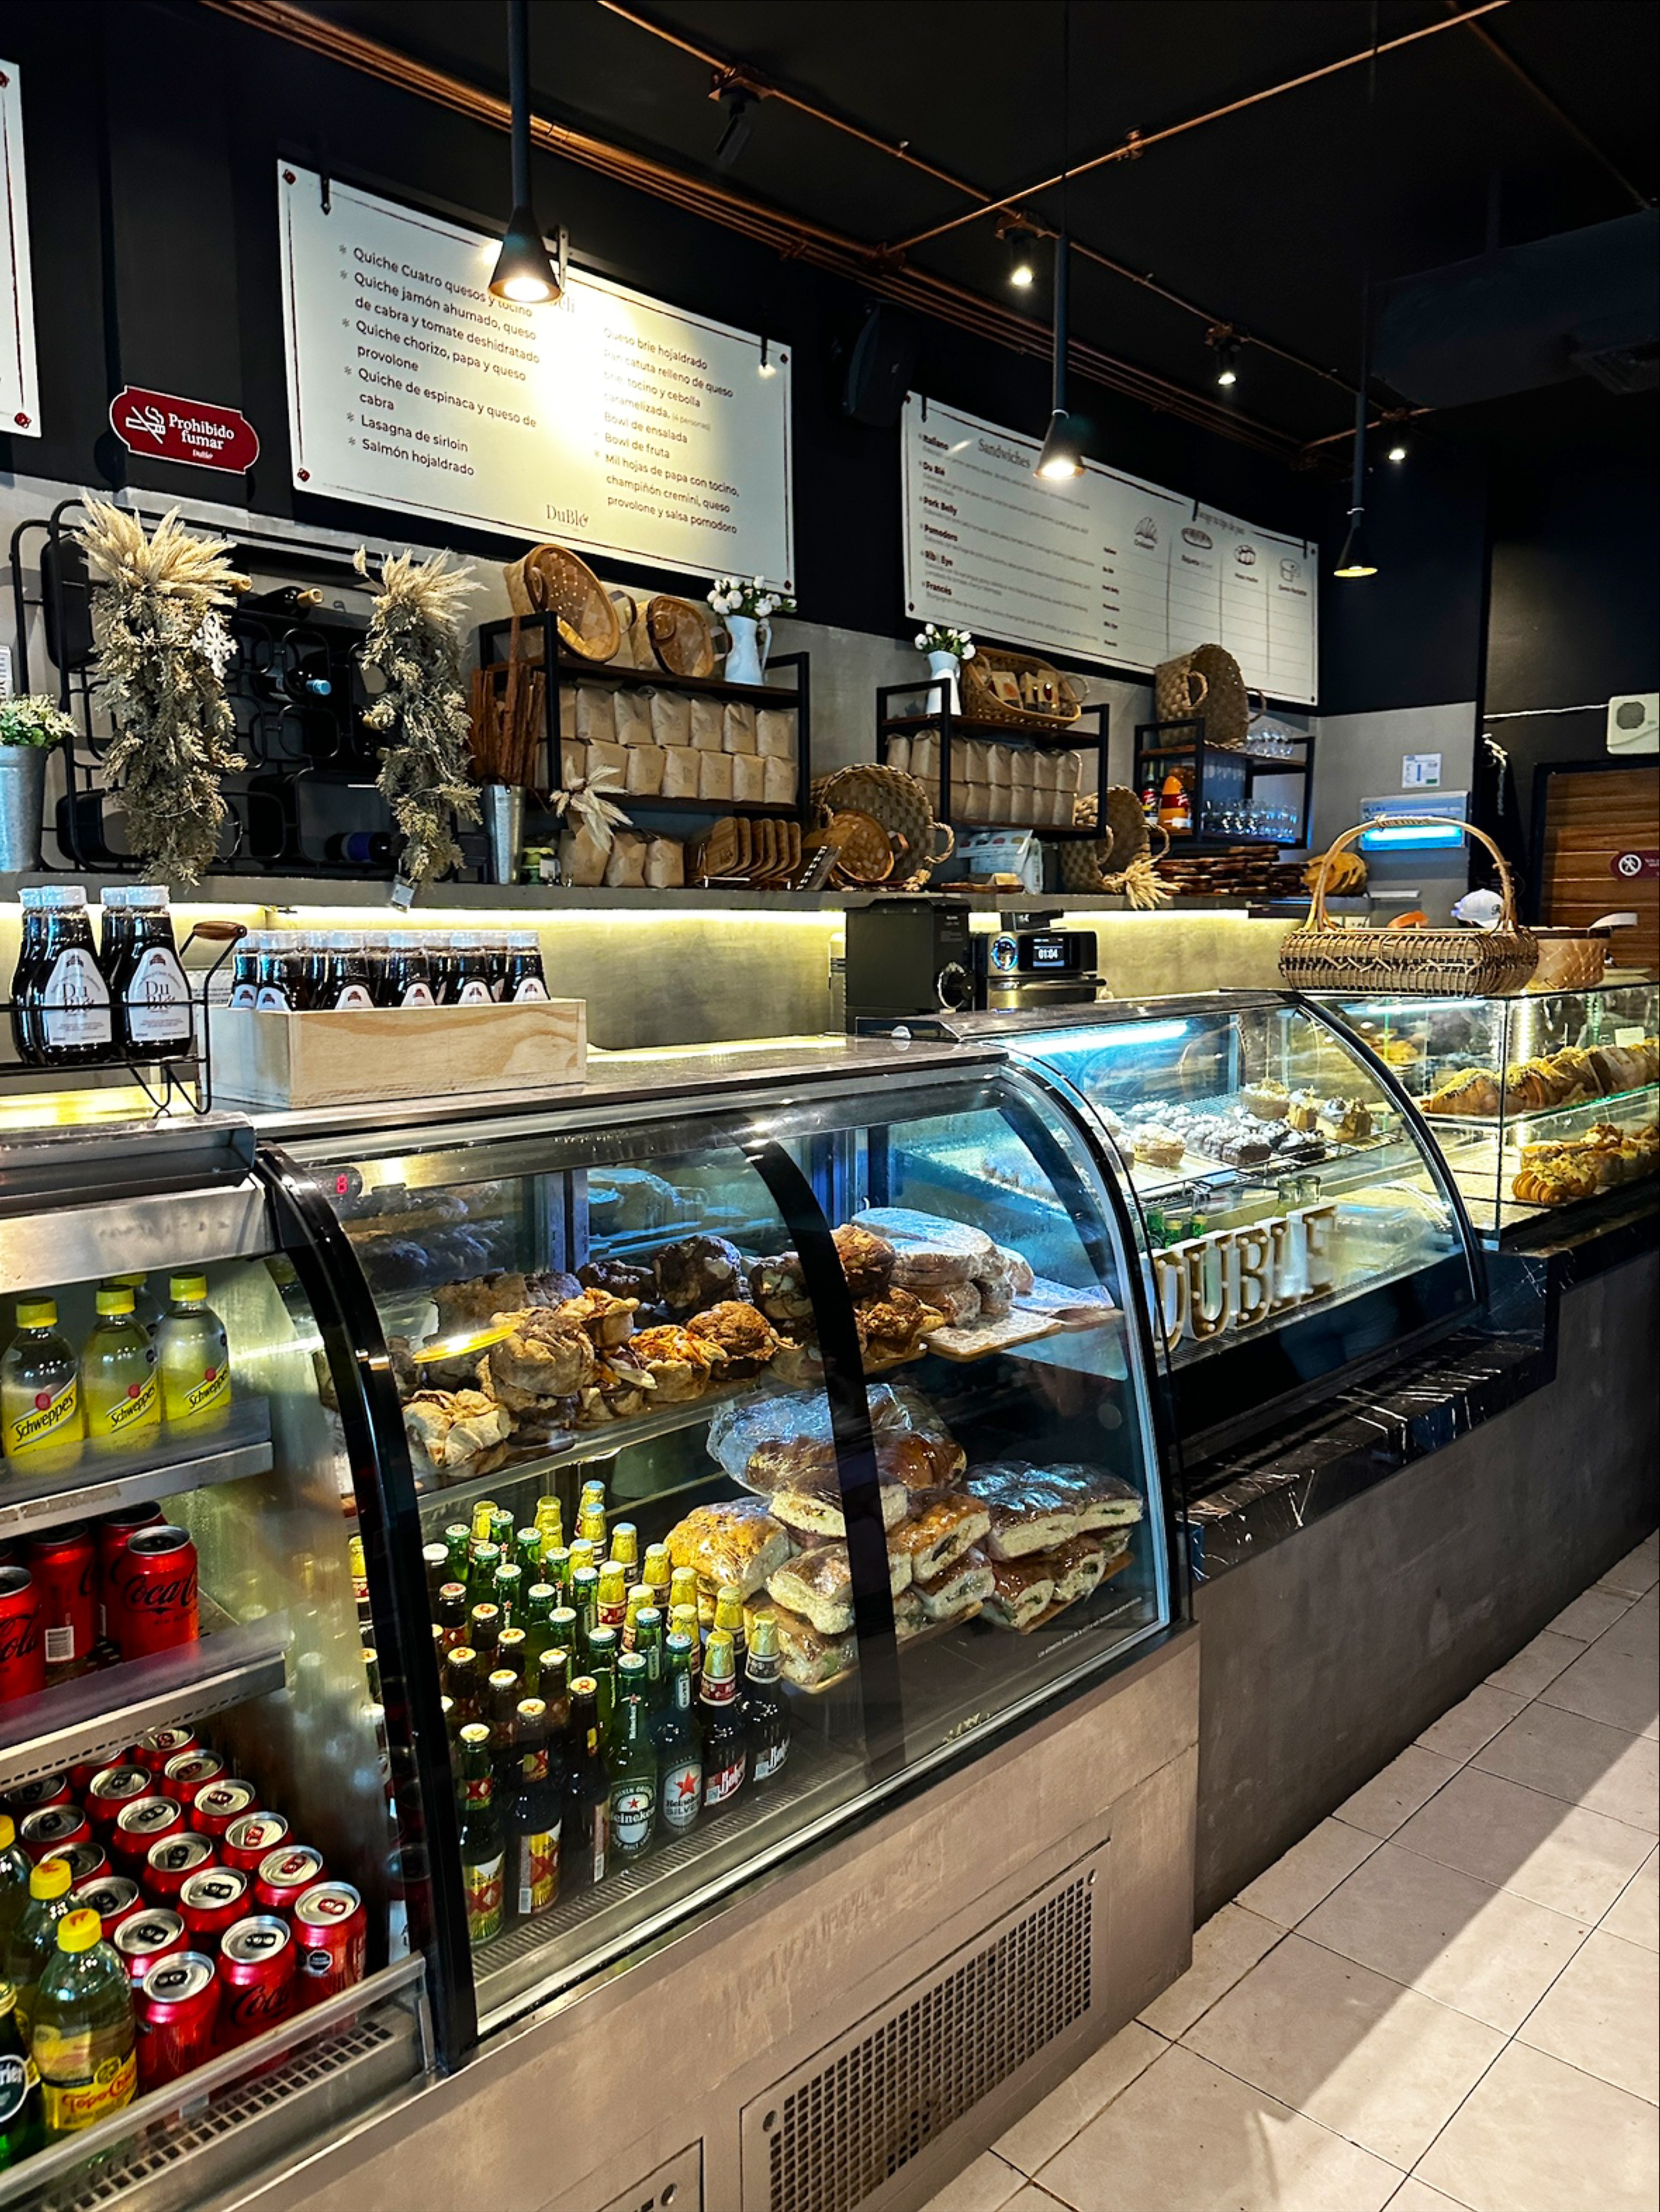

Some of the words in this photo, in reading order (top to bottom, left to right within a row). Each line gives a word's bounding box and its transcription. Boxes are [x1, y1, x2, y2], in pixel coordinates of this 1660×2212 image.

[354, 247, 398, 272] Quiche
[402, 265, 442, 287] Cuatro
[445, 281, 486, 302] quesos
[488, 295, 495, 307] y
[355, 272, 399, 296] Quiche
[401, 286, 440, 310] jamón
[444, 303, 500, 330] ahumado,
[504, 323, 536, 340] queso
[355, 296, 370, 311] de
[375, 305, 408, 323] cabra
[411, 316, 419, 327] y
[422, 318, 464, 340] tomate
[466, 333, 540, 364] deshidratado
[604, 327, 634, 345] Queso
[638, 338, 655, 353] brie
[659, 344, 707, 370] hojaldrado
[356, 320, 400, 343] Quiche
[404, 335, 449, 359] chorizo,
[453, 352, 480, 367] papa
[483, 361, 490, 372] y
[493, 364, 526, 380] queso
[358, 346, 418, 371] provolone
[358, 368, 402, 389] Quiche
[406, 382, 420, 395] de
[424, 389, 475, 410] espinaca
[477, 403, 484, 414] y
[487, 407, 520, 423] queso
[523, 416, 536, 427] de
[628, 378, 657, 394] tocino
[660, 389, 666, 399] y
[667, 391, 700, 408] cebolla
[659, 368, 690, 384] relleno
[692, 377, 704, 389] de
[706, 383, 733, 398] queso
[360, 394, 394, 410] cabra
[168, 413, 234, 440] Prohibido
[181, 429, 224, 450] fumar
[362, 415, 412, 438] Lasagna
[415, 430, 430, 442] de
[433, 434, 468, 452] sirloin
[604, 411, 628, 427] Bowl
[631, 421, 643, 432] de
[646, 425, 687, 443] ensalada
[605, 432, 629, 447] Bowl
[632, 441, 643, 451] de
[646, 443, 670, 458] fruta
[362, 439, 408, 460] Salmón
[412, 450, 475, 475] hojaldrado
[605, 454, 619, 465] Mil
[622, 458, 648, 473] hojas
[650, 465, 662, 477] de
[665, 470, 687, 483] papa
[690, 477, 707, 487] con
[709, 480, 739, 498] tocino,
[606, 475, 662, 496] champiñón
[664, 490, 702, 507] cremini,
[703, 500, 730, 513] queso
[608, 497, 656, 515] provolone
[658, 508, 664, 518] y
[666, 510, 688, 522] salsa
[691, 516, 738, 534] pomodoro
[145, 981, 169, 994] Du
[15, 1396, 73, 1442] Schweppes
[112, 1385, 154, 1428] Schweppes
